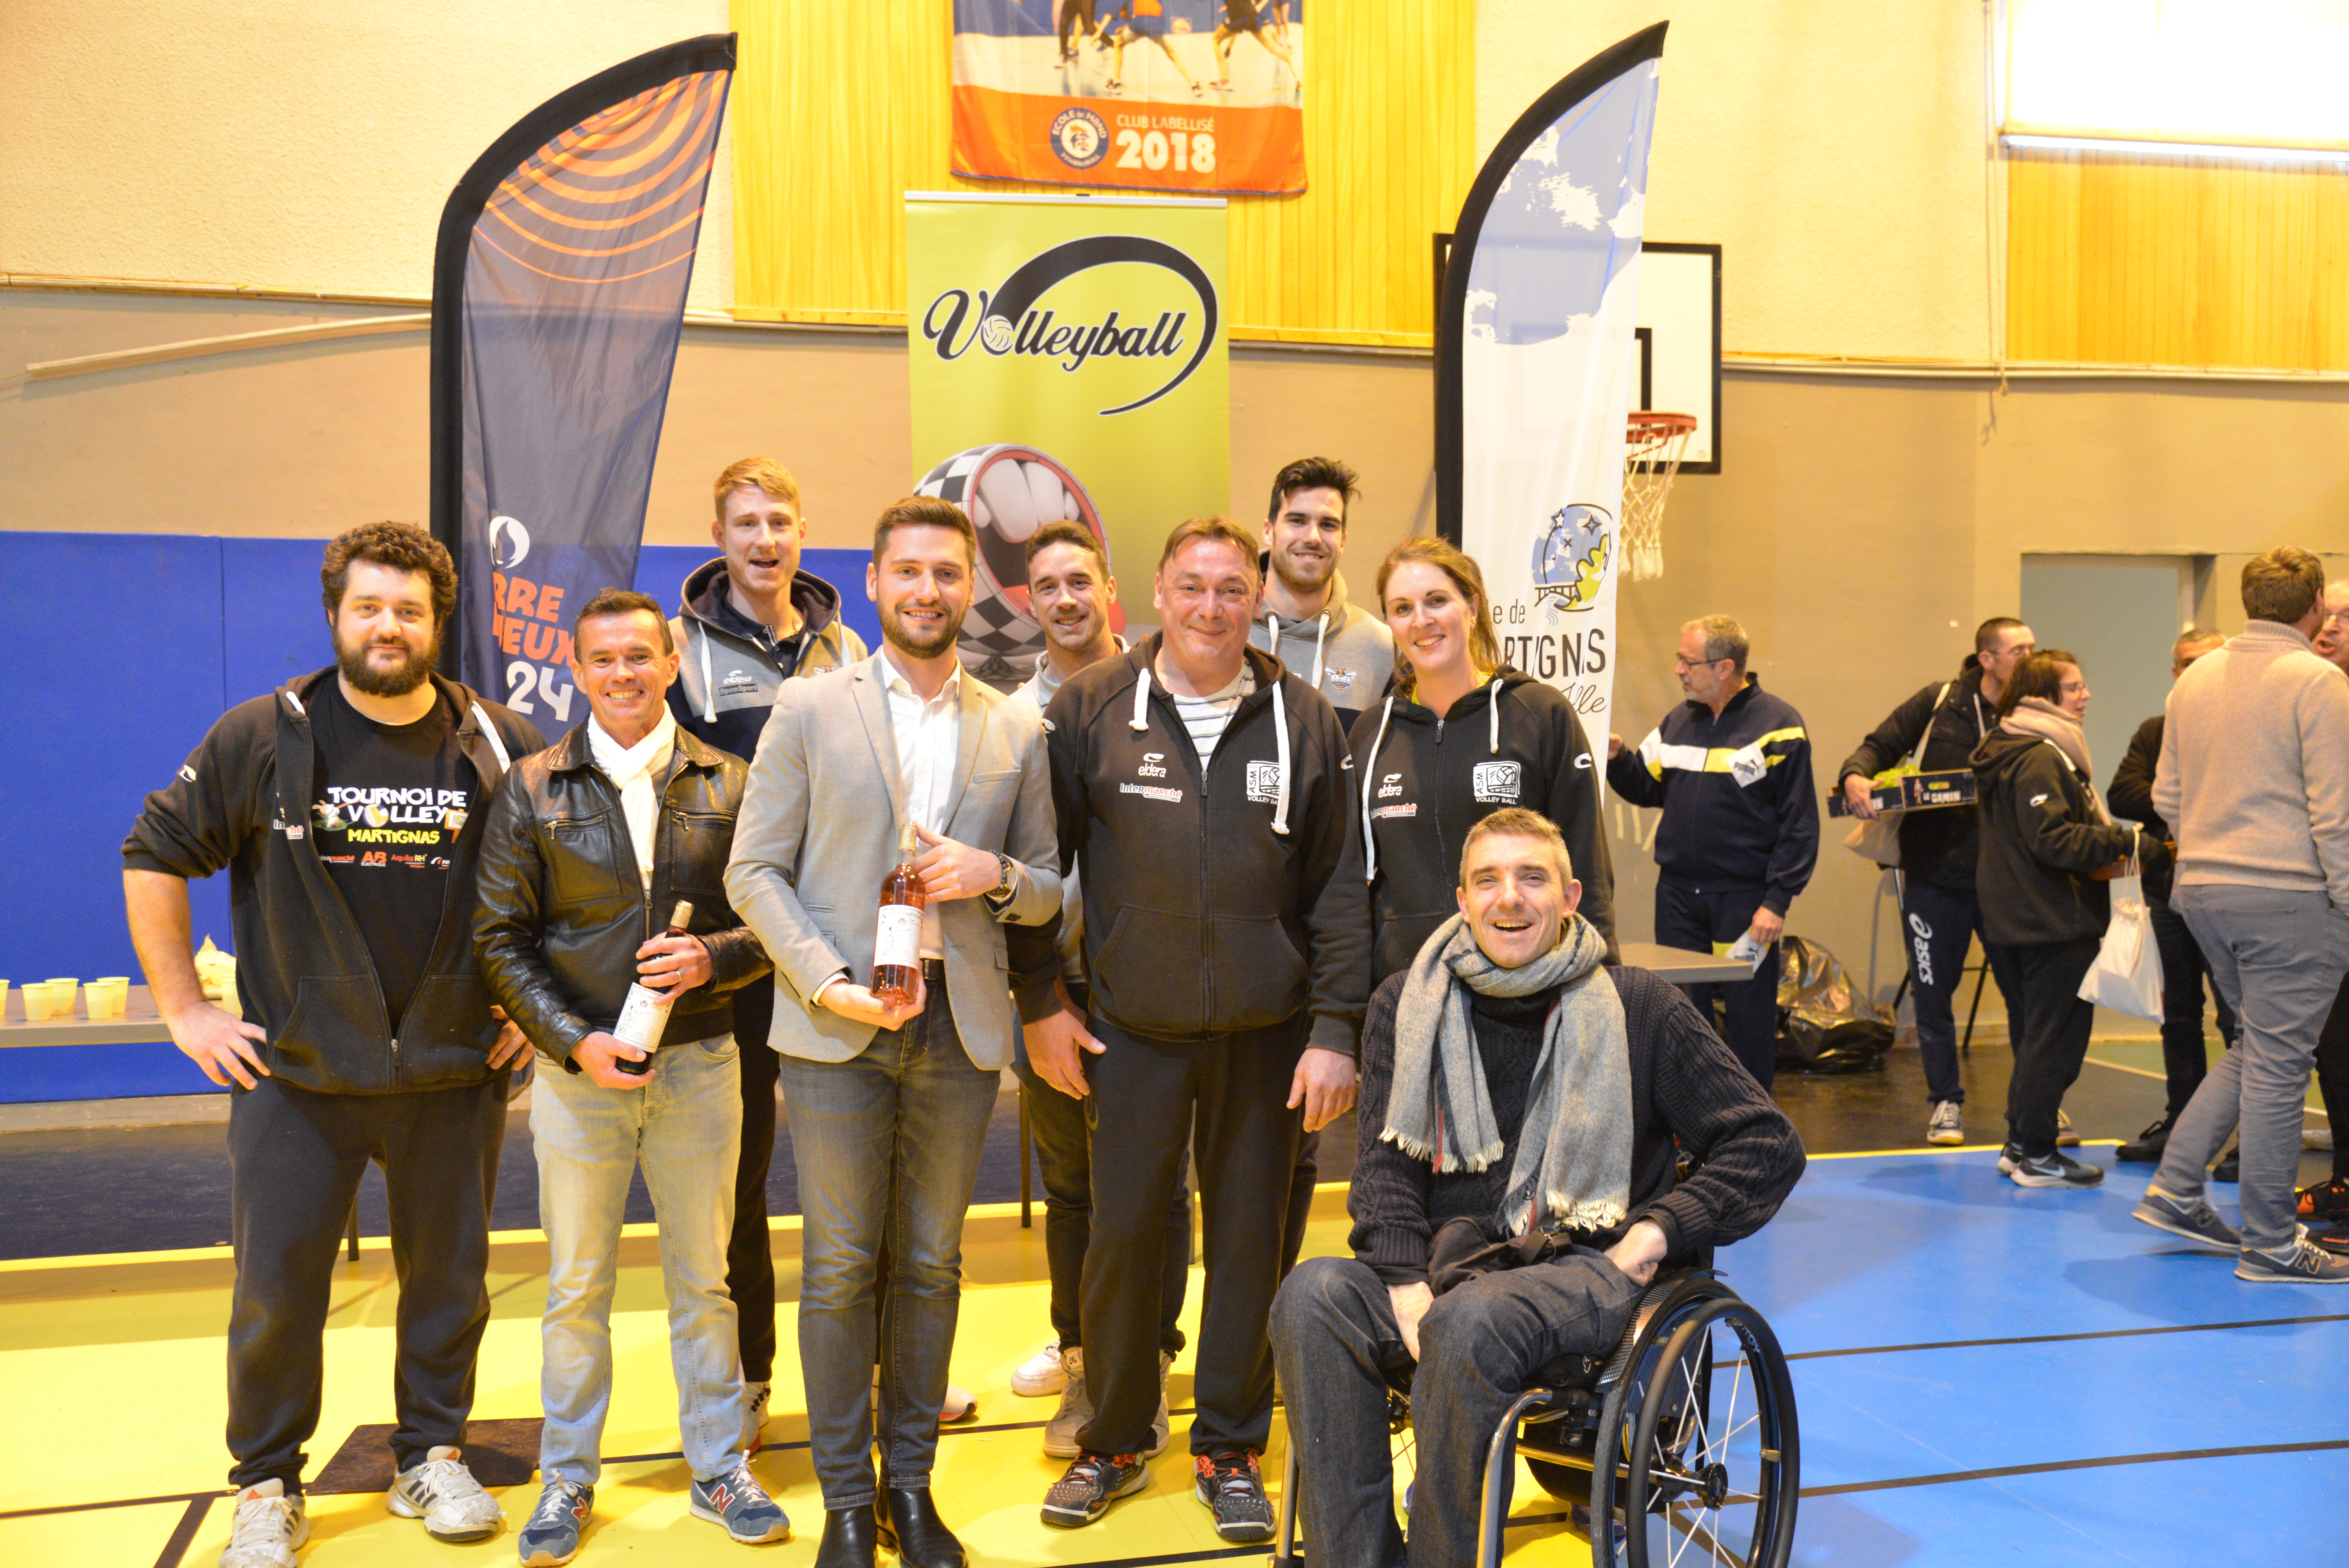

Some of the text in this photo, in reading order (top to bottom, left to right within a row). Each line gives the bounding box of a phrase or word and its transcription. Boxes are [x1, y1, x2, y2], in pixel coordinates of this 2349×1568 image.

[1117, 114, 1215, 132] CLUB LABELLISÉ
[1116, 129, 1216, 173] 2018
[1510, 599, 1525, 624] de
[723, 676, 752, 684] eldera
[507, 660, 573, 722] 24
[719, 685, 757, 695] SponSport
[1138, 763, 1166, 778] eldera
[1734, 762, 1756, 776] PUMA
[438, 790, 467, 807] DE
[1378, 784, 1402, 798] eldera
[348, 829, 440, 844] MARTIGNAS
[1914, 936, 1934, 985] asics
